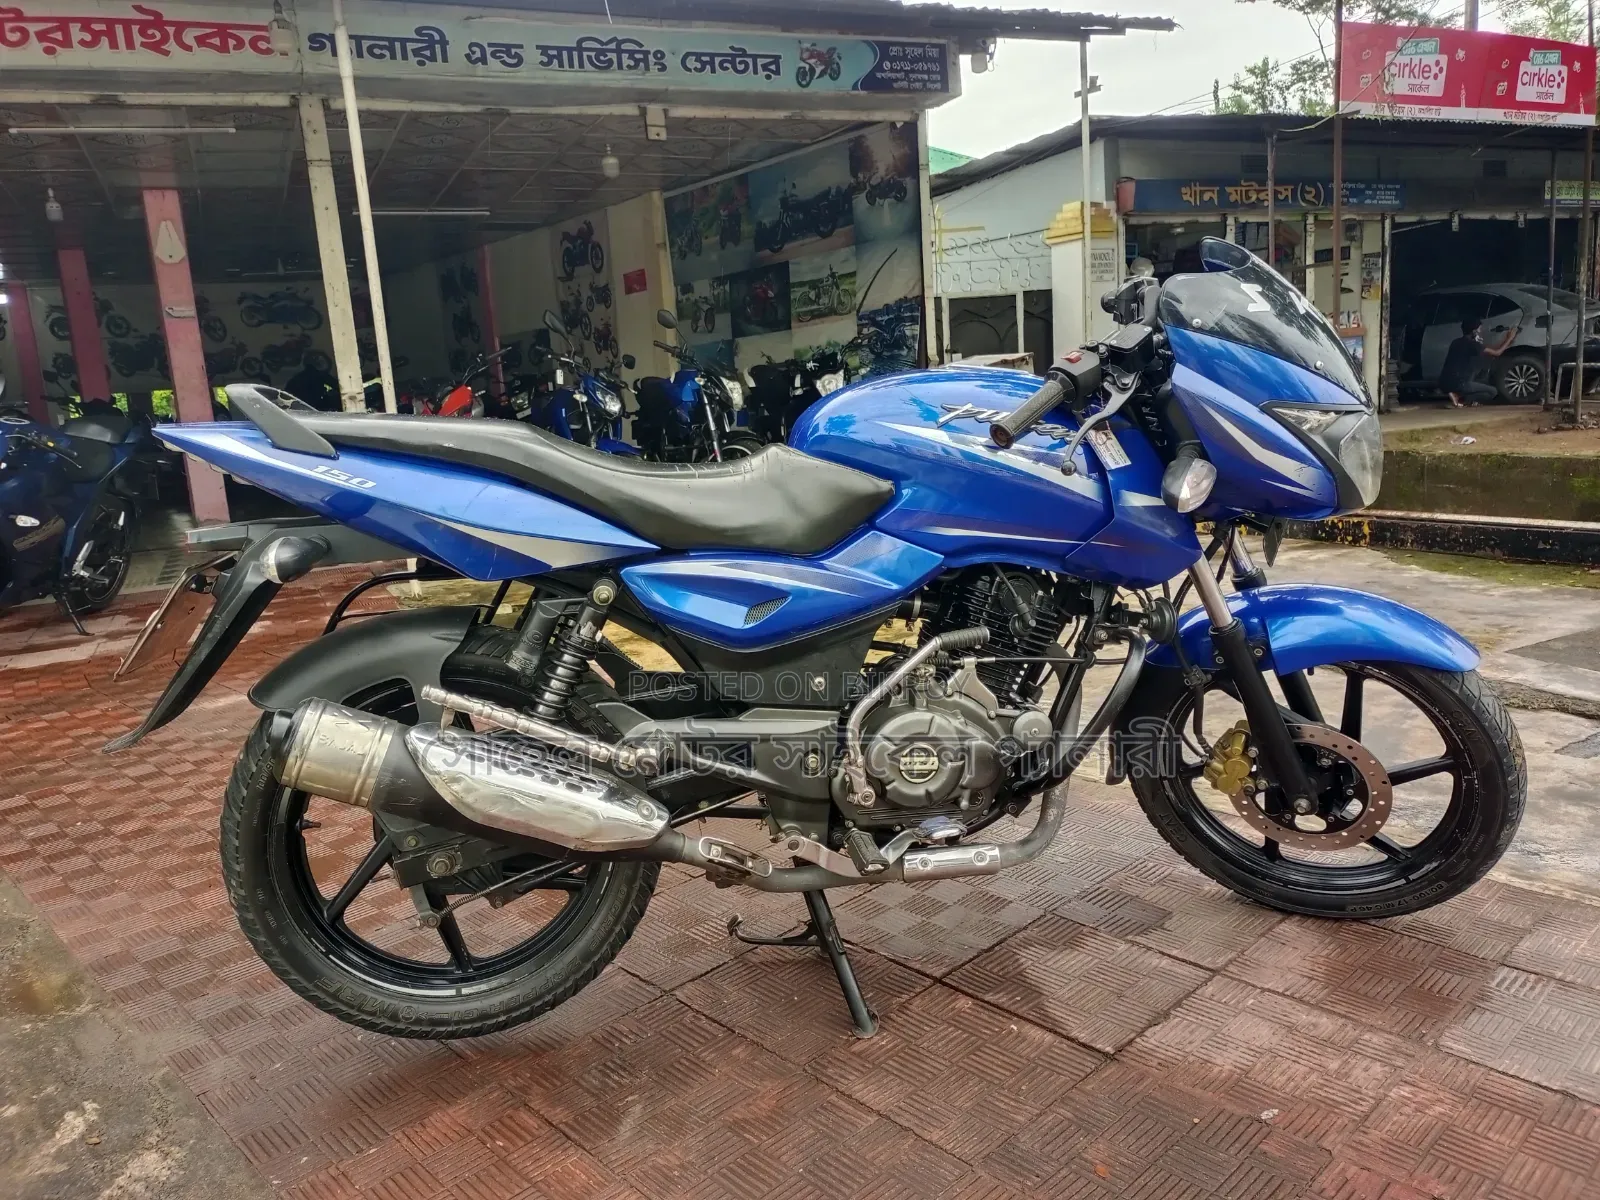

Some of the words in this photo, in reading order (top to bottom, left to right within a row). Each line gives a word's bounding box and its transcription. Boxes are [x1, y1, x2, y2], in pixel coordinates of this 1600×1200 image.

[464, 41, 524, 68] এন্ড
[535, 36, 667, 73] সার্ভিসিং
[681, 45, 782, 80] সেন্টার
[1388, 57, 1432, 80] cirkle
[1520, 67, 1556, 88] cirkle
[1181, 182, 1220, 207] খান
[1297, 181, 1325, 207] (২)
[312, 465, 377, 489] 150
[314, 976, 401, 1020] MRF
